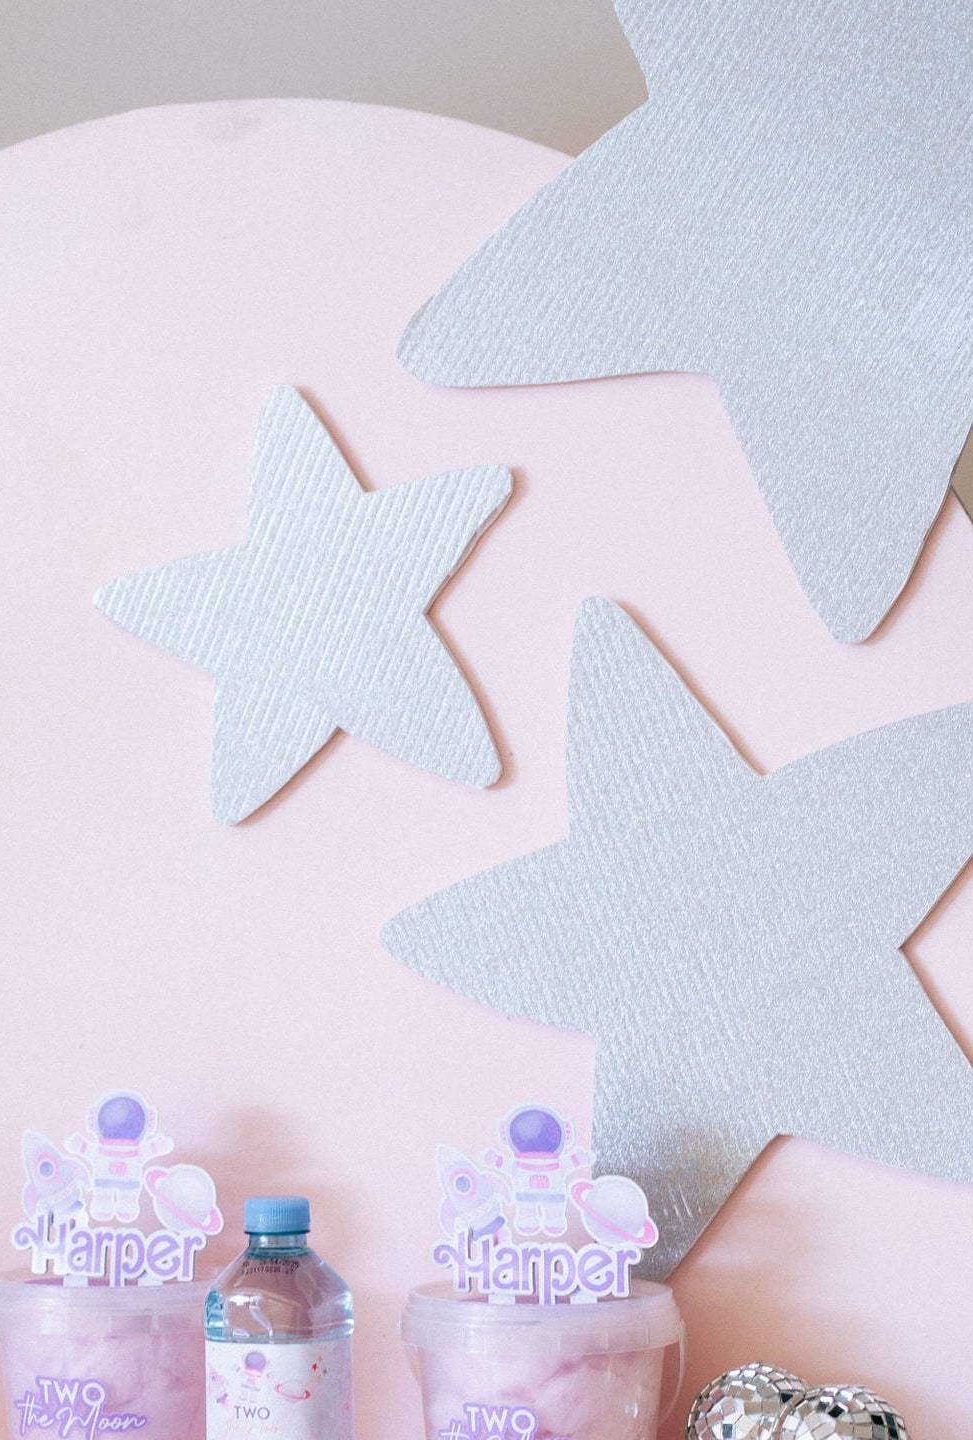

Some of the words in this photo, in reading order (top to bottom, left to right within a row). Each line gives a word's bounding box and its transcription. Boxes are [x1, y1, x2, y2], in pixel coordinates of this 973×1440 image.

[13, 1214, 204, 1287] Harper
[433, 1231, 638, 1305] Harper
[38, 1378, 106, 1406] TWO
[16, 1394, 54, 1434] the
[233, 1405, 270, 1420] TWO
[466, 1405, 536, 1435] TWO
